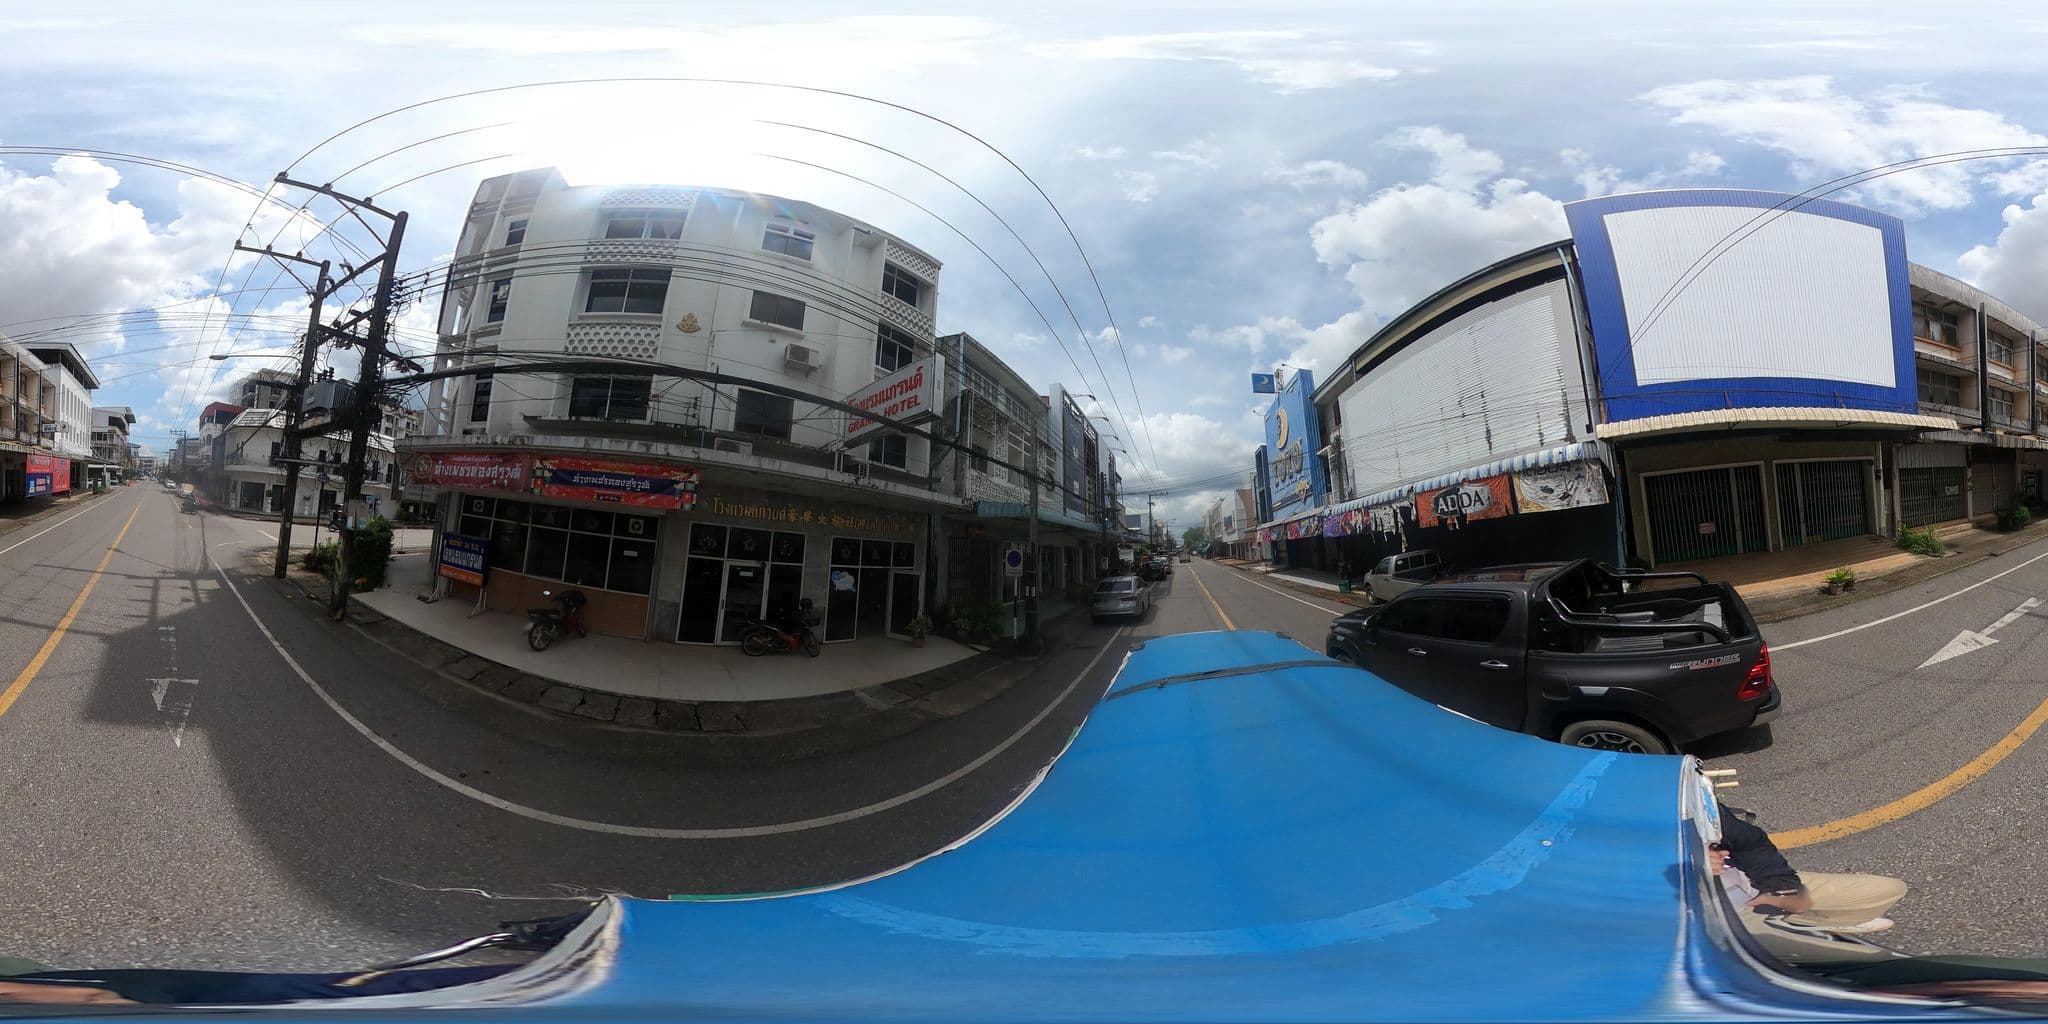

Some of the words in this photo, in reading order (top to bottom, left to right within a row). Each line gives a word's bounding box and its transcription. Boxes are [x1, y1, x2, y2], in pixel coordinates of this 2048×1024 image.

[848, 366, 923, 410] งแรมแกรนด์
[884, 394, 921, 417] HOTEL
[1438, 490, 1484, 514] ADDA
